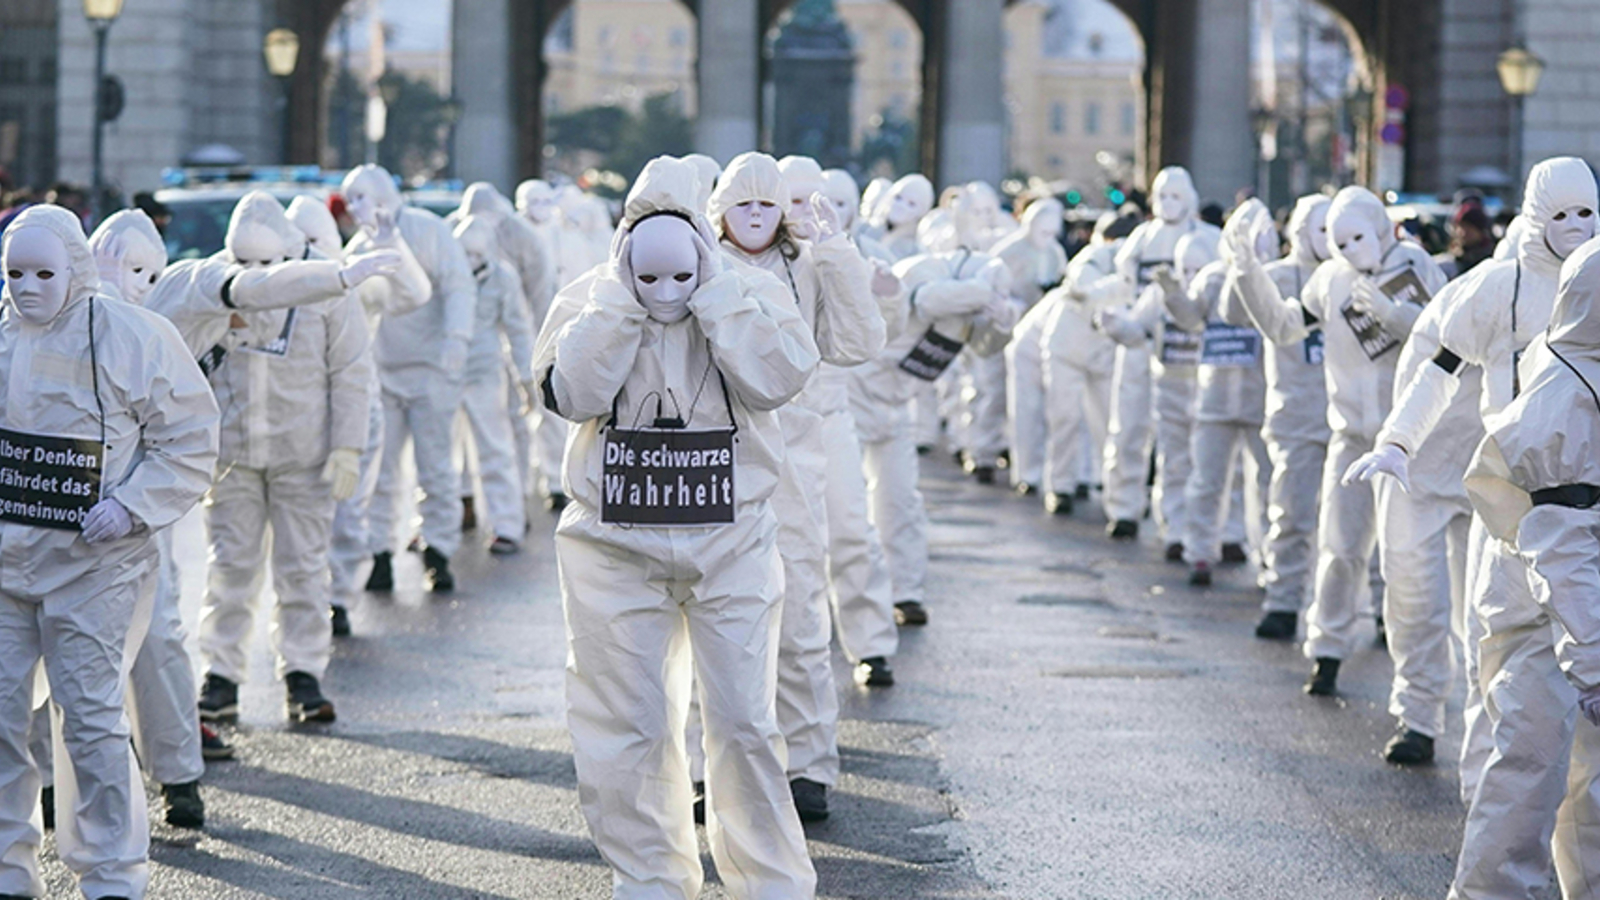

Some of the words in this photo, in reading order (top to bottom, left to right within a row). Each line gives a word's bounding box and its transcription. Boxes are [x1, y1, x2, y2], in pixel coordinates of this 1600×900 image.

[0, 440, 30, 460] lber
[34, 446, 96, 467] Denken
[606, 442, 636, 466] Die
[642, 444, 730, 467] schwarze
[0, 467, 58, 492] fährdet
[61, 478, 91, 496] das
[605, 474, 731, 506] Wahrheit
